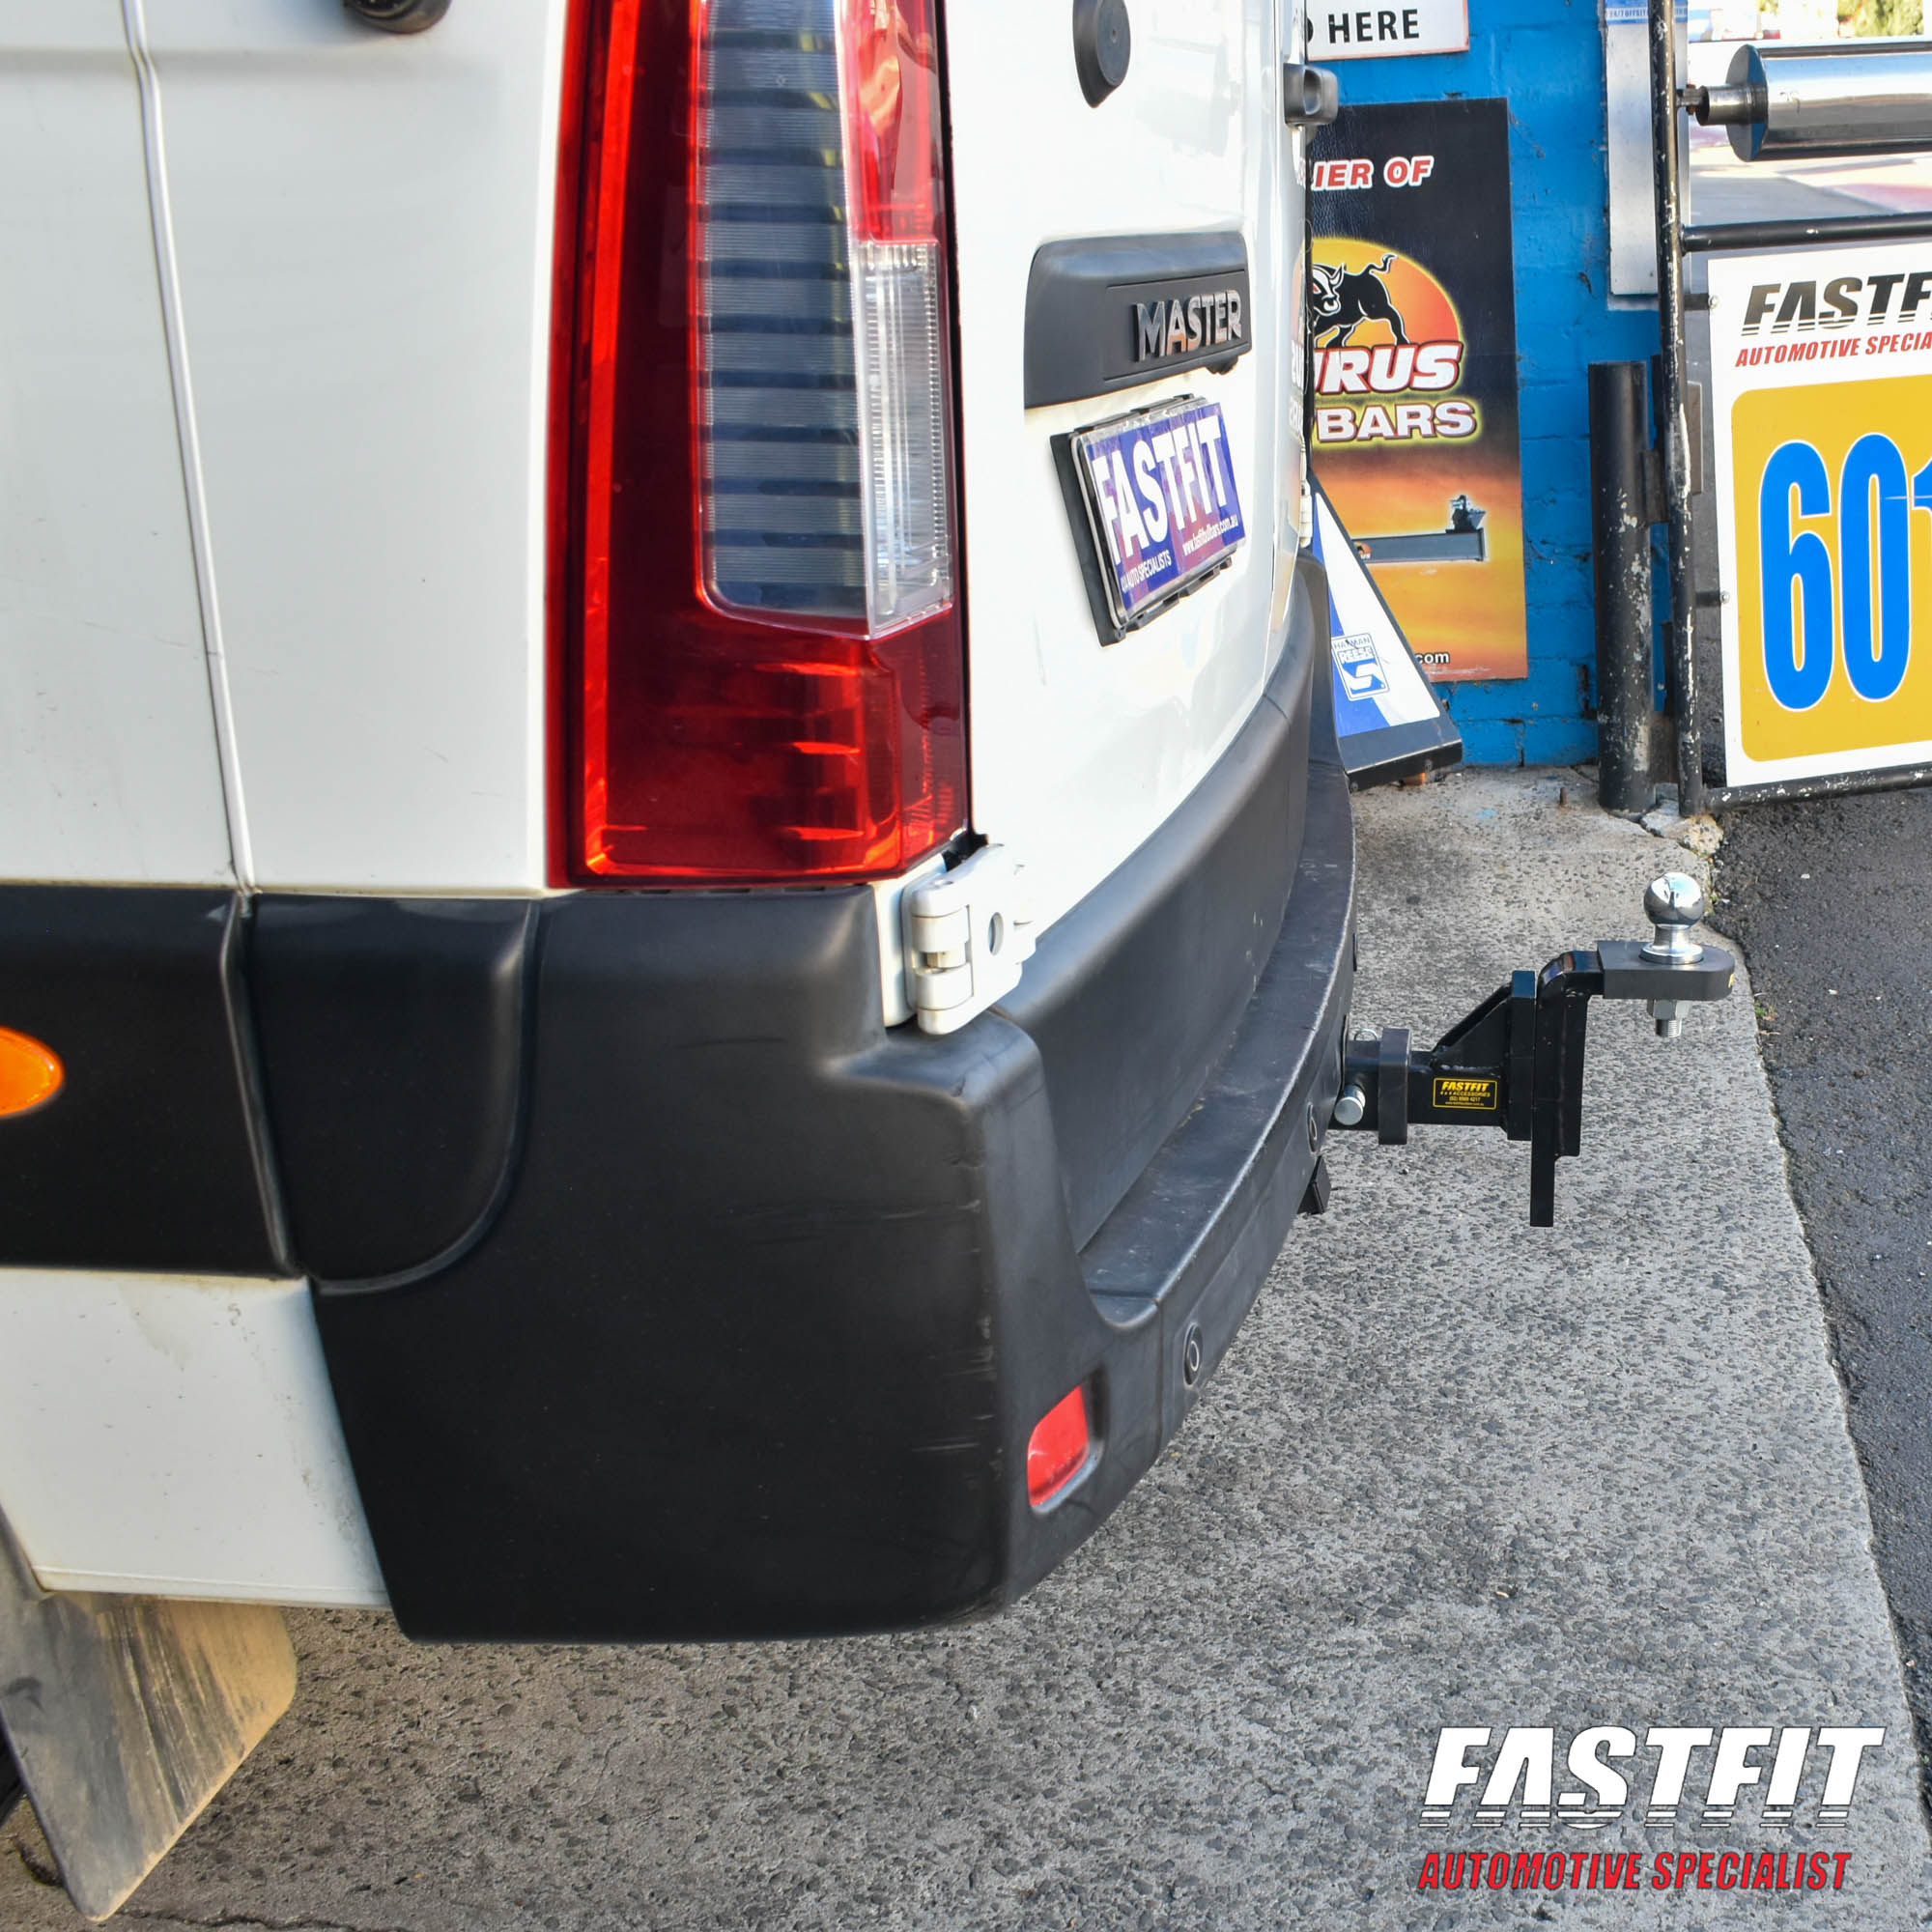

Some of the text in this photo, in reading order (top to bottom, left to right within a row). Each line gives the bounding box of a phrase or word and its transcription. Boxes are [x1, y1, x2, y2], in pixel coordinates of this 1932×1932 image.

[1328, 9, 1420, 44] HERE
[1383, 155, 1435, 187] OF
[1134, 290, 1242, 361] MASTER
[1314, 340, 1463, 395] RUS
[1735, 337, 1861, 368] AUTOMOTIVE
[1316, 401, 1477, 443] BARS
[1092, 413, 1228, 566] FASTFIT
[1441, 1081, 1489, 1092] FASTFIT
